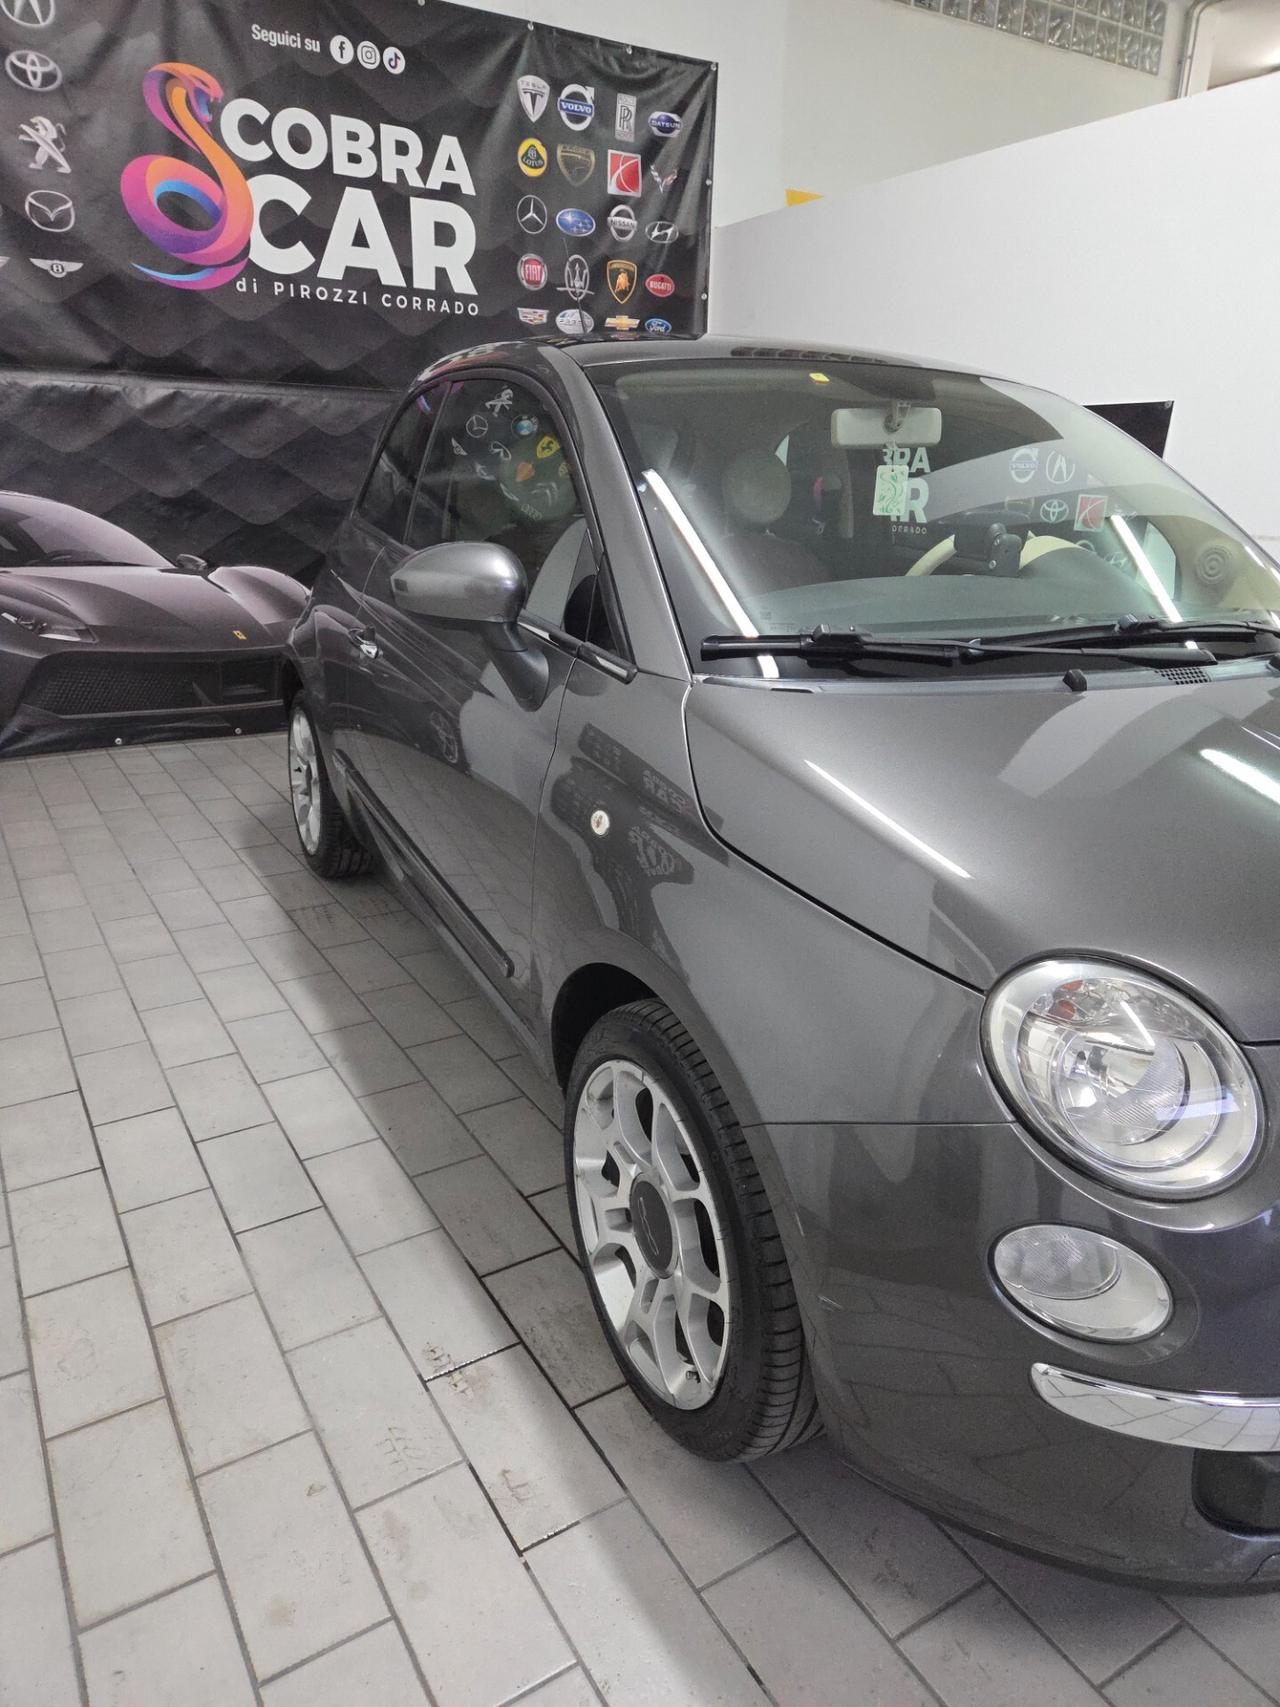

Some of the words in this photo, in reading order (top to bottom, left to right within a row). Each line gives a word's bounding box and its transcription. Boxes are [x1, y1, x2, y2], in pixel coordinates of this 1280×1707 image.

[252, 24, 301, 50] Seguici
[304, 37, 321, 53] su
[561, 102, 592, 114] VOLVO
[651, 120, 681, 128] DATSUN
[220, 98, 476, 196] COBRA
[523, 157, 544, 167] LOTUS
[611, 218, 637, 229] NISSAN
[247, 174, 478, 295] CAR
[525, 263, 543, 277] FIAT
[650, 280, 672, 291] BUGATTI
[236, 278, 258, 294] di
[274, 282, 368, 306] PIROZZI
[381, 294, 479, 316] CORRADO
[649, 322, 666, 333] Ford
